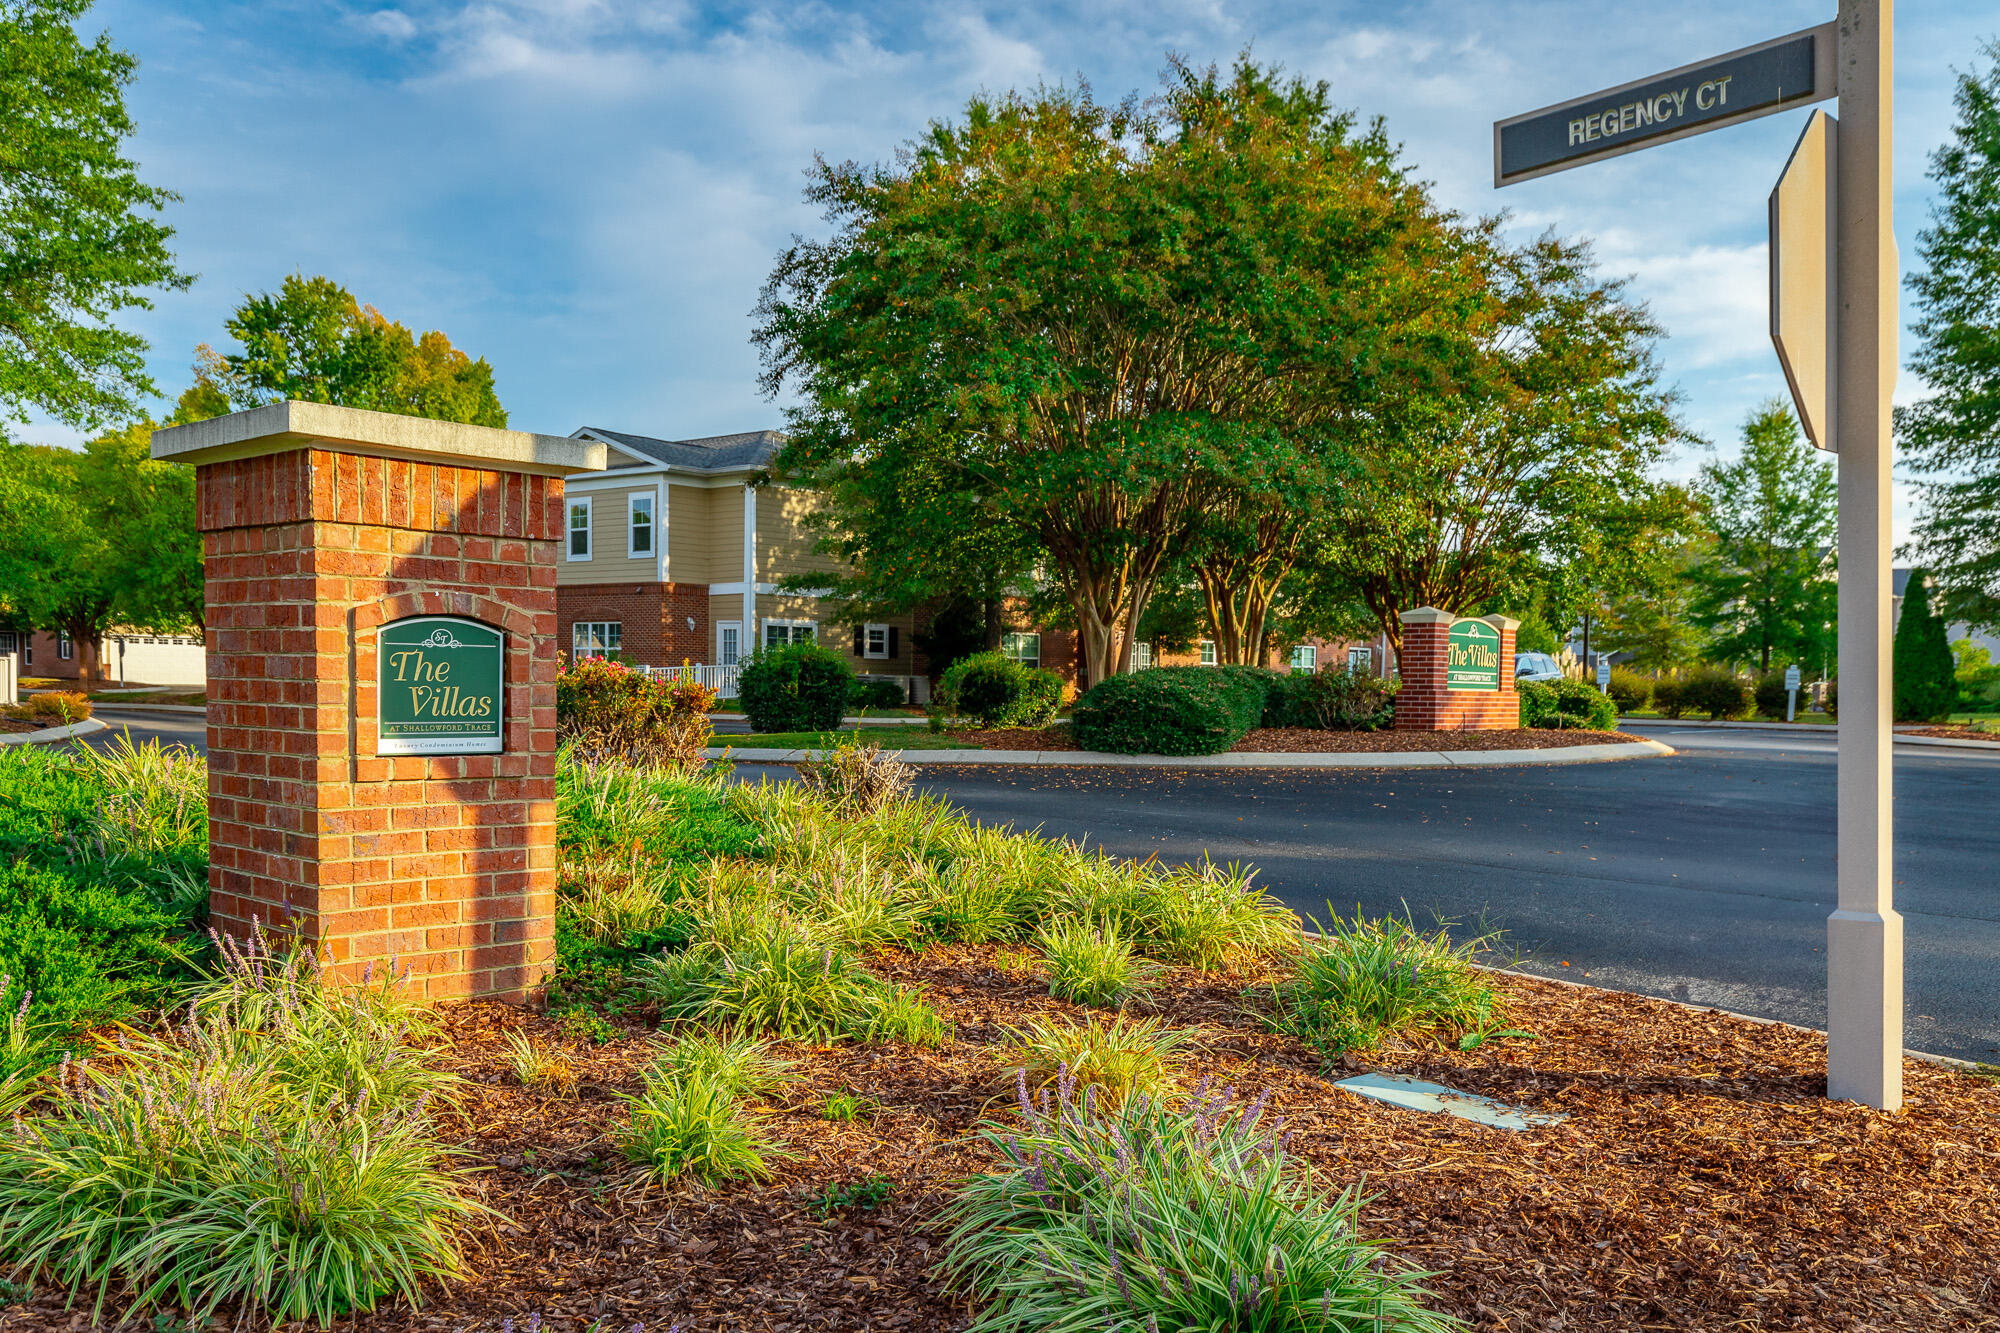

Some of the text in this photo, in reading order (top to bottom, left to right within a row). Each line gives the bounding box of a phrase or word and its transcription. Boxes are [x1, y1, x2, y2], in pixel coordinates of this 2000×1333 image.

[1569, 75, 1732, 147] REGENCY CT
[389, 649, 450, 682] The
[1448, 643, 1497, 668] The Villas
[408, 685, 492, 717] Villas
[389, 725, 400, 733] AT
